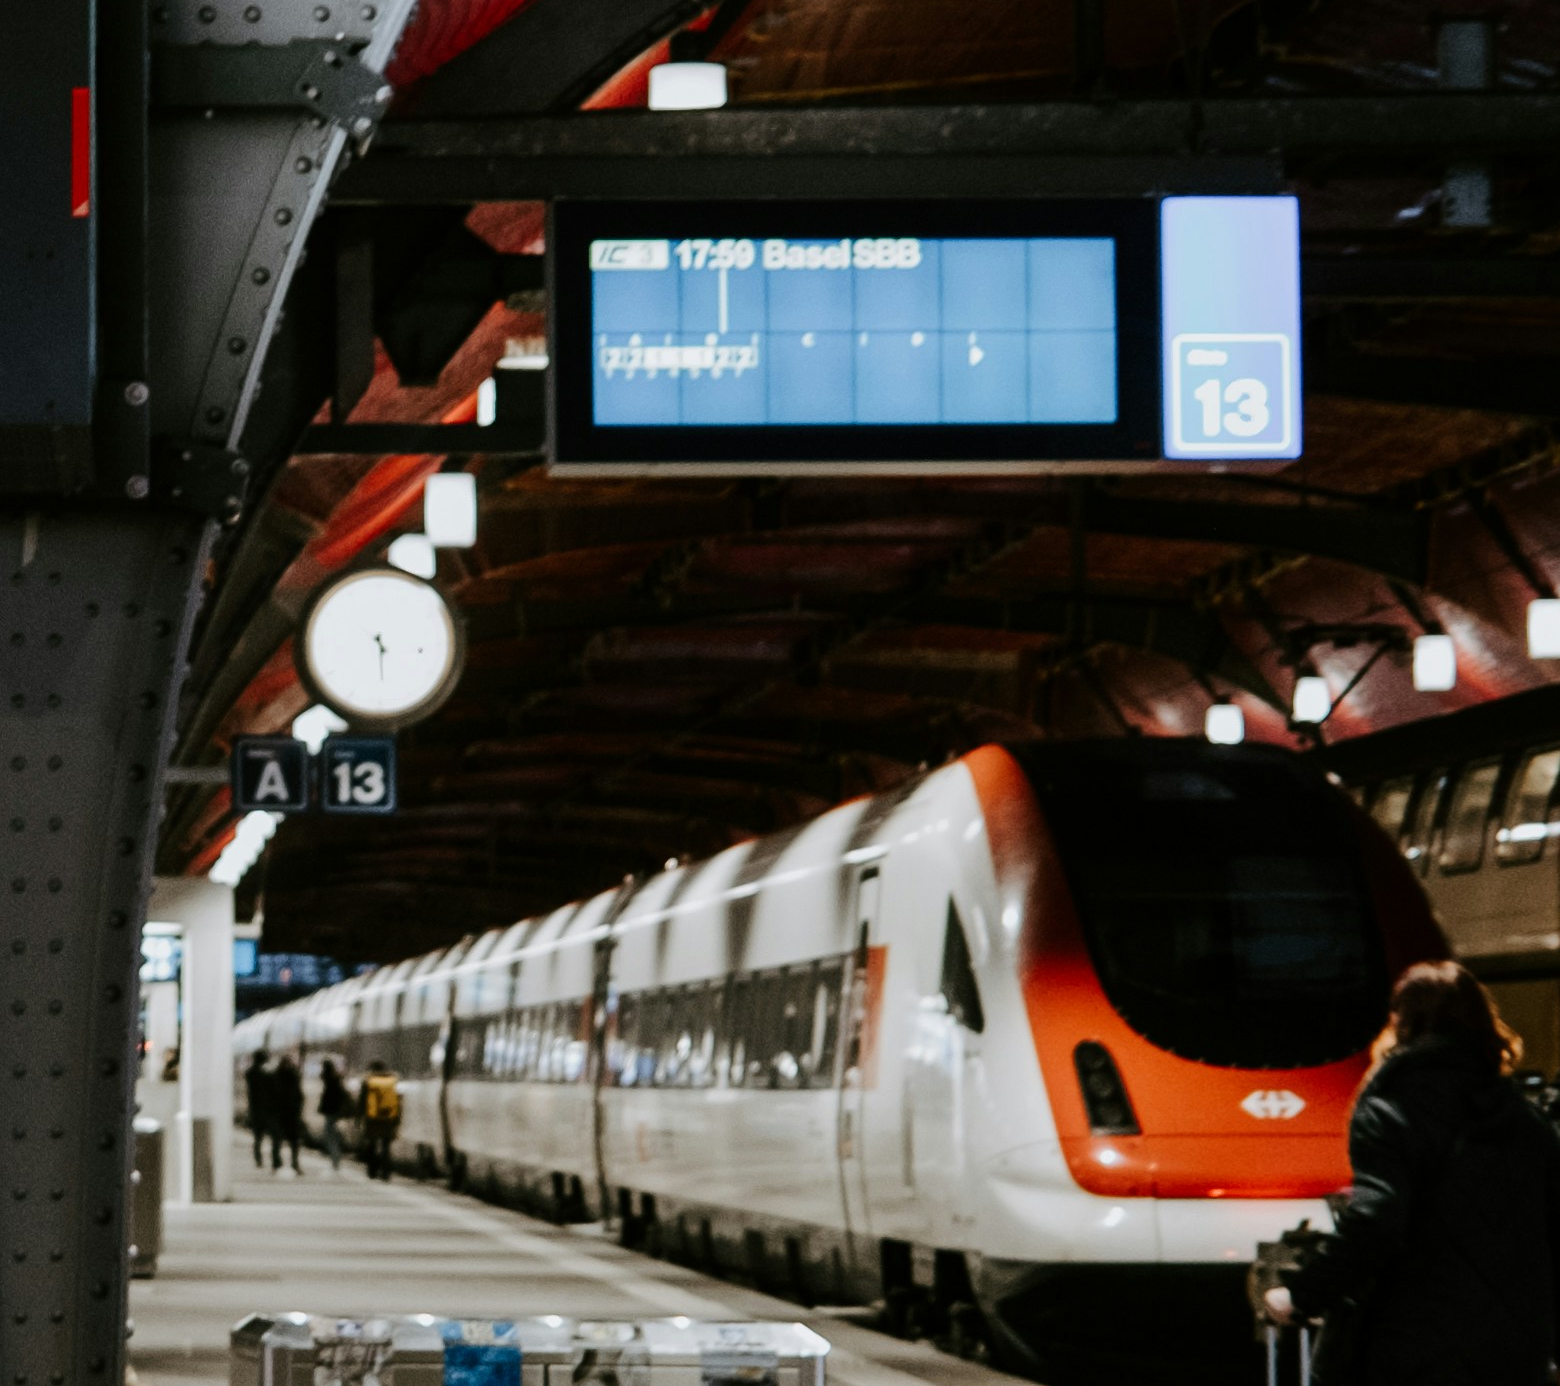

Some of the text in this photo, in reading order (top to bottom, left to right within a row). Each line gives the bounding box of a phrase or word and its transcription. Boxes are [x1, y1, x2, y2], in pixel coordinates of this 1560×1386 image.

[764, 239, 850, 269] Basel
[854, 238, 921, 269] SBB
[1193, 377, 1269, 438] 13
[255, 760, 386, 804] A 13
